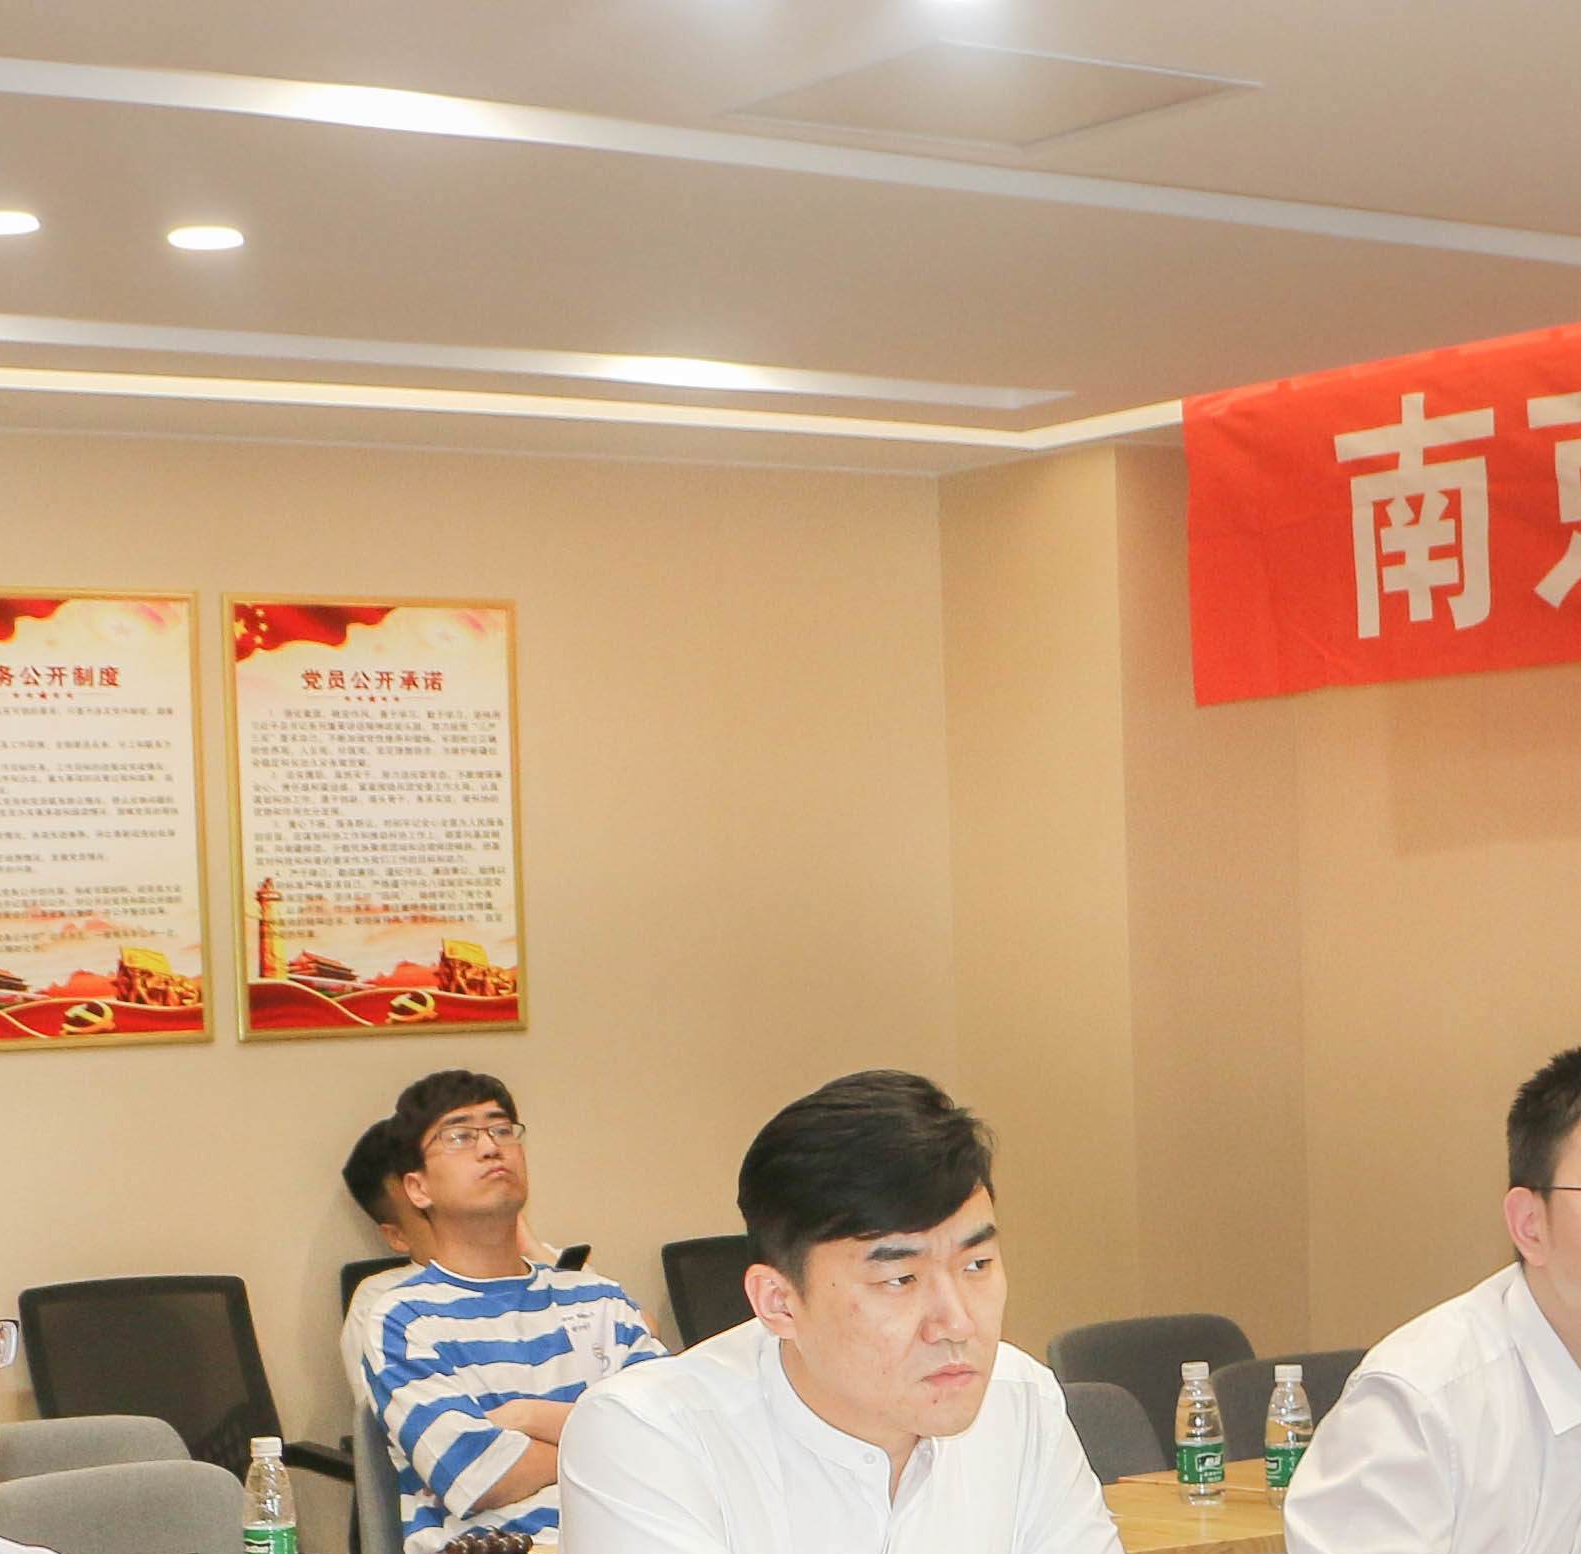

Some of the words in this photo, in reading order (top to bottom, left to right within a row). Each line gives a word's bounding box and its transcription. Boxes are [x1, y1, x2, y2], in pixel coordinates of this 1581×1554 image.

[301, 670, 444, 692] 党员公开承诺
